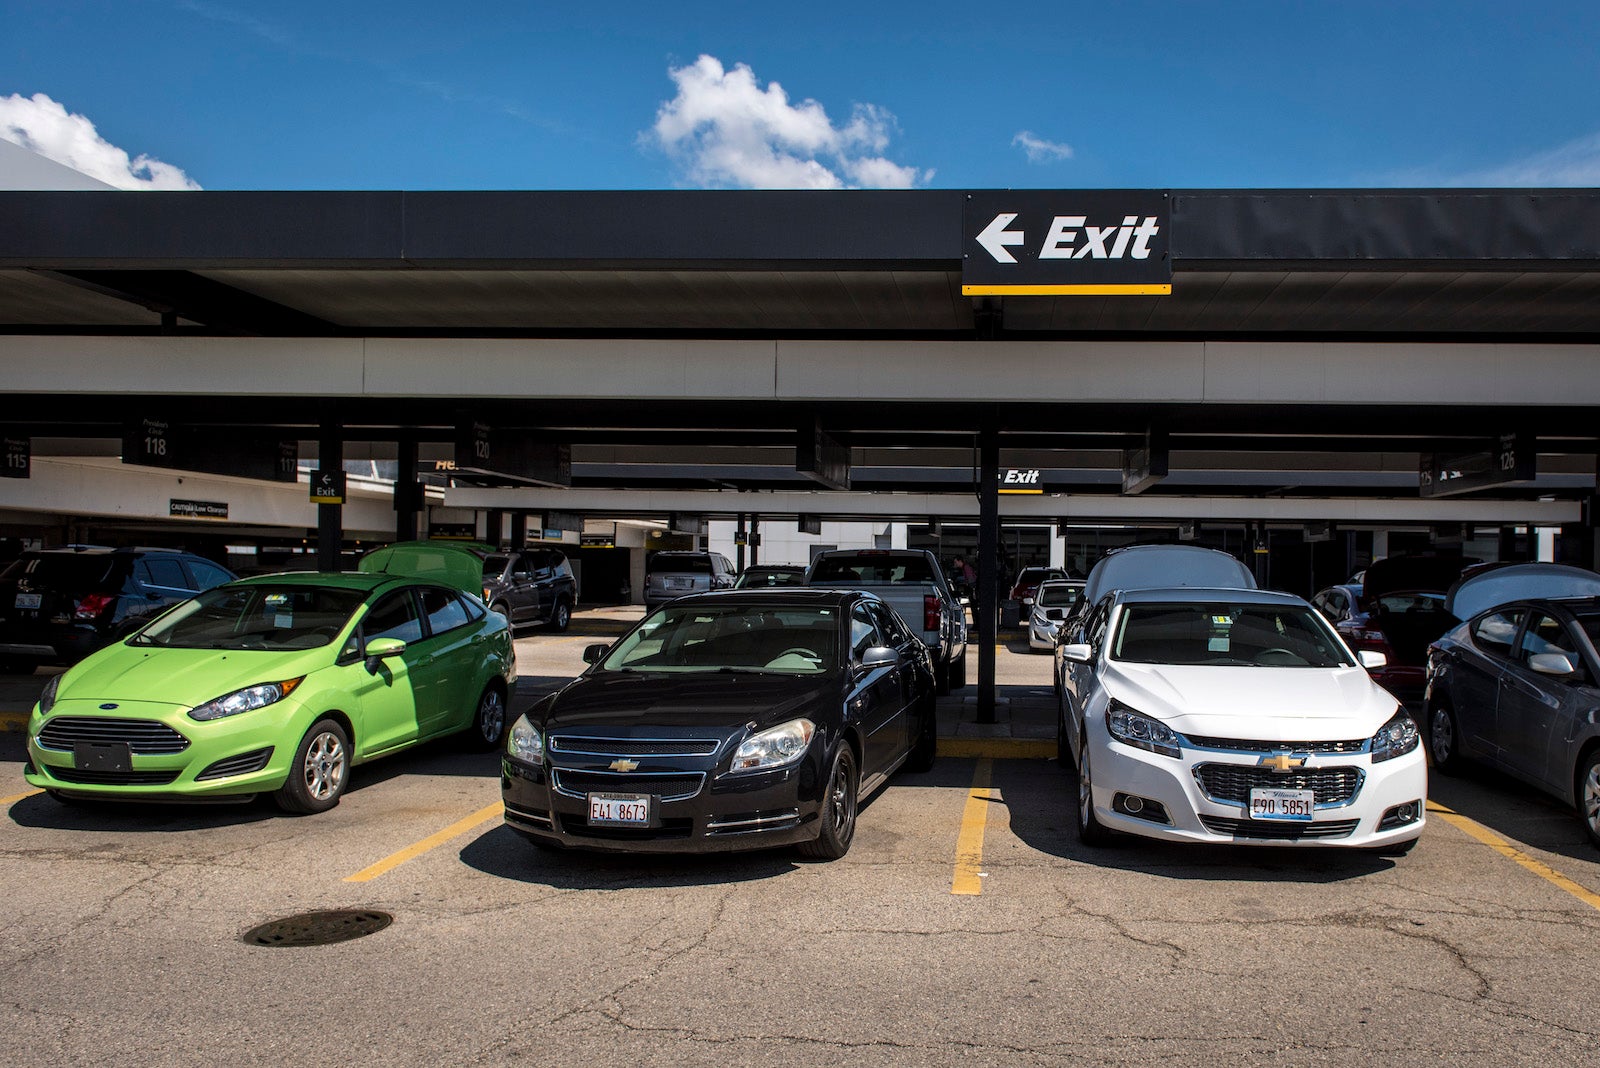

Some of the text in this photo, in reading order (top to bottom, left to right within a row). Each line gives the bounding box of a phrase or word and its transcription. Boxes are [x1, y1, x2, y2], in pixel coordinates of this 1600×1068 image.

[1038, 215, 1160, 260] Exit
[144, 437, 167, 456] 118
[475, 439, 490, 459] 120
[5, 453, 28, 469] 115
[280, 457, 297, 473] 117
[1500, 450, 1515, 471] 126
[1003, 469, 1040, 484] Exit
[316, 486, 336, 496] Exit
[592, 803, 646, 821] E41 8673
[1253, 798, 1310, 816] E90 5851
